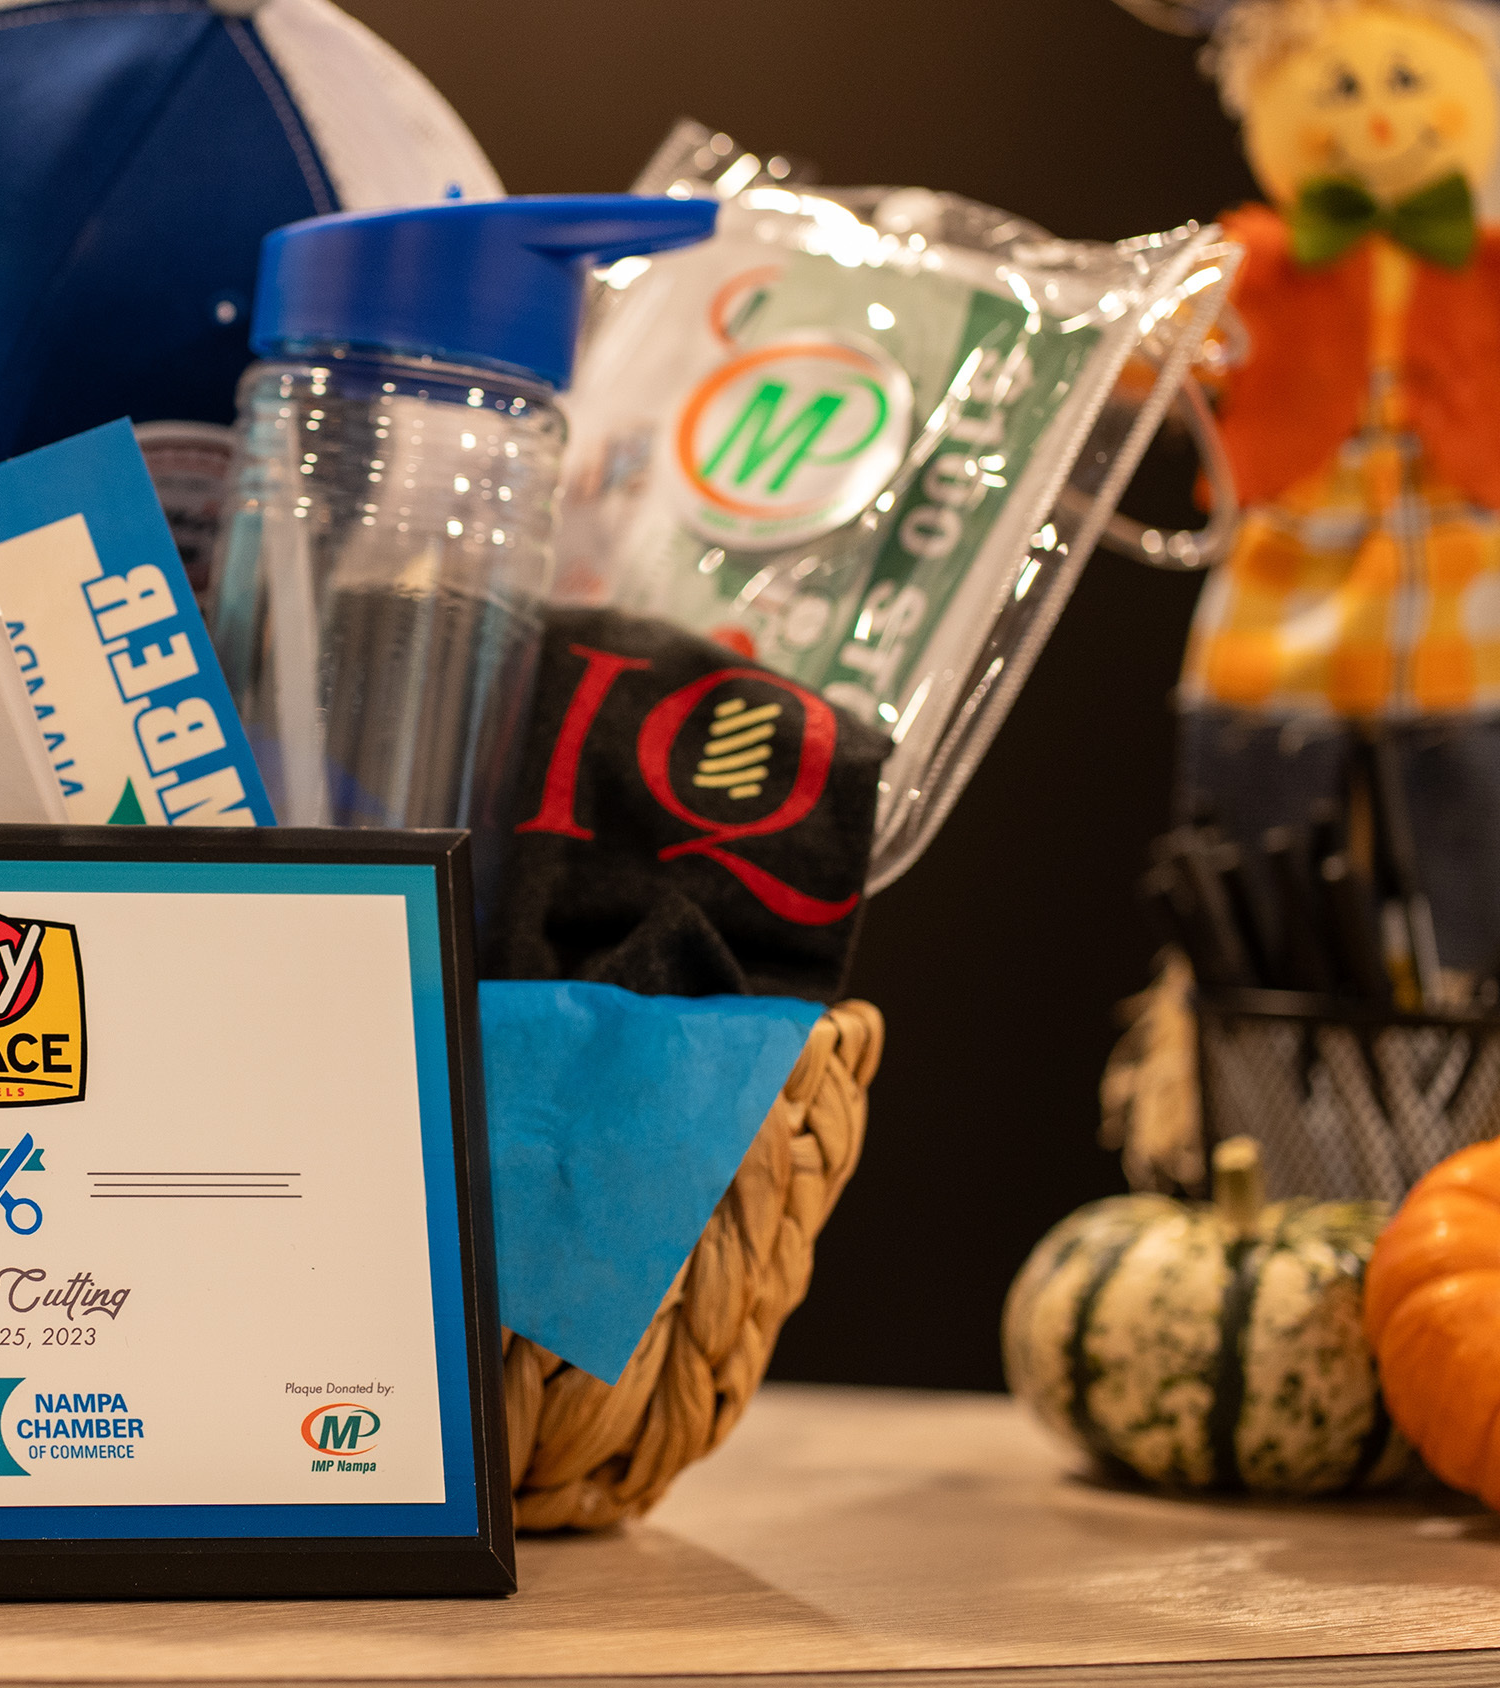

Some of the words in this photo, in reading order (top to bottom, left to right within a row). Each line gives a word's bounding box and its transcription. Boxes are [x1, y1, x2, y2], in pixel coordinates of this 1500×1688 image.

[514, 643, 860, 926] IQ
[41, 1327, 97, 1347] 2023
[284, 1381, 323, 1398] Plaque
[325, 1381, 374, 1395] Donated
[376, 1381, 395, 1397] by:
[34, 1393, 129, 1414] NAMPA
[16, 1418, 145, 1440] CHAMBER
[28, 1445, 47, 1460] OF
[50, 1444, 135, 1460] COMMERCE
[310, 1459, 335, 1473] IMP
[336, 1459, 377, 1475] Nampa
